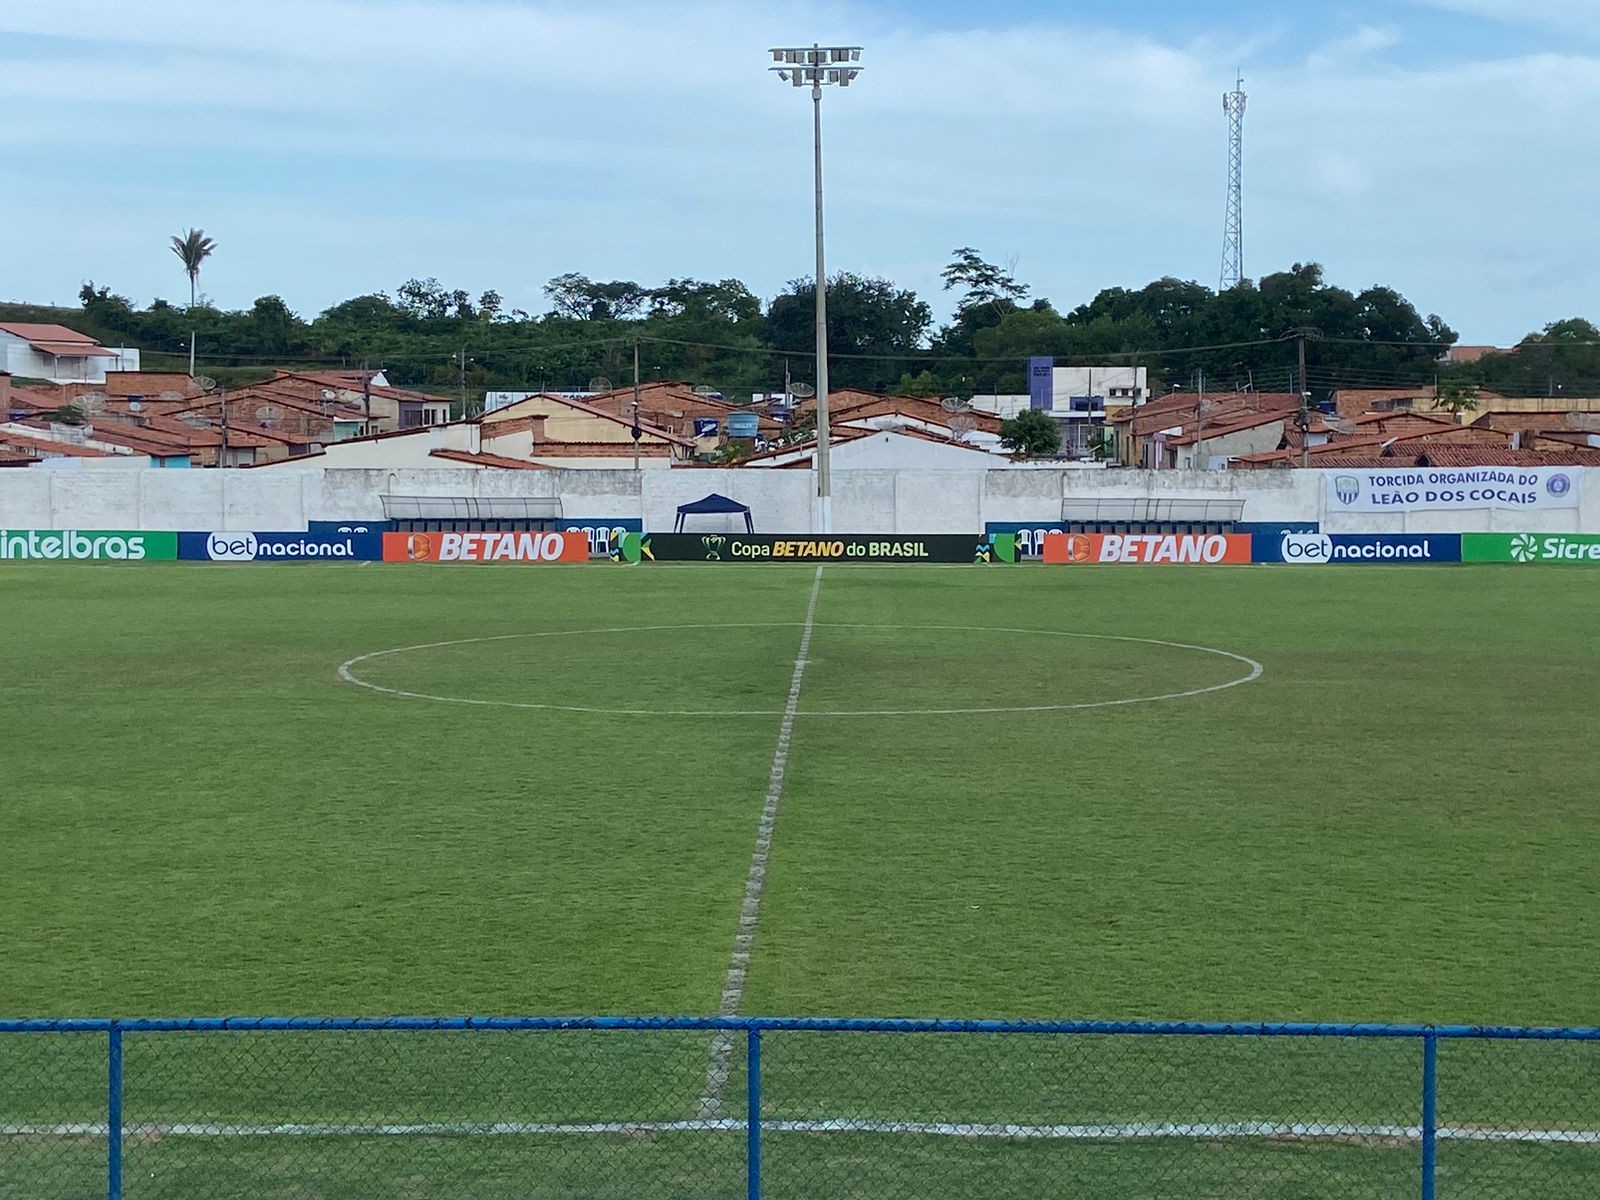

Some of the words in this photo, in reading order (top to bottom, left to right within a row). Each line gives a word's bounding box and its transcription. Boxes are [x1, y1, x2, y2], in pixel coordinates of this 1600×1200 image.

[1369, 475, 1424, 487] TORCIDA
[1429, 471, 1515, 485] ORGANIZADA
[1519, 474, 1538, 486] DO
[1371, 490, 1419, 505] LEÃO
[1426, 490, 1465, 502] DOS
[1470, 489, 1537, 504] COCAIS
[0, 530, 145, 559] intelbras
[439, 533, 564, 561] BETANO
[731, 542, 770, 558] Copa
[772, 541, 844, 557] BETANO
[846, 542, 866, 556] do
[869, 542, 929, 557] BRASIL
[1099, 534, 1227, 563] BETANO
